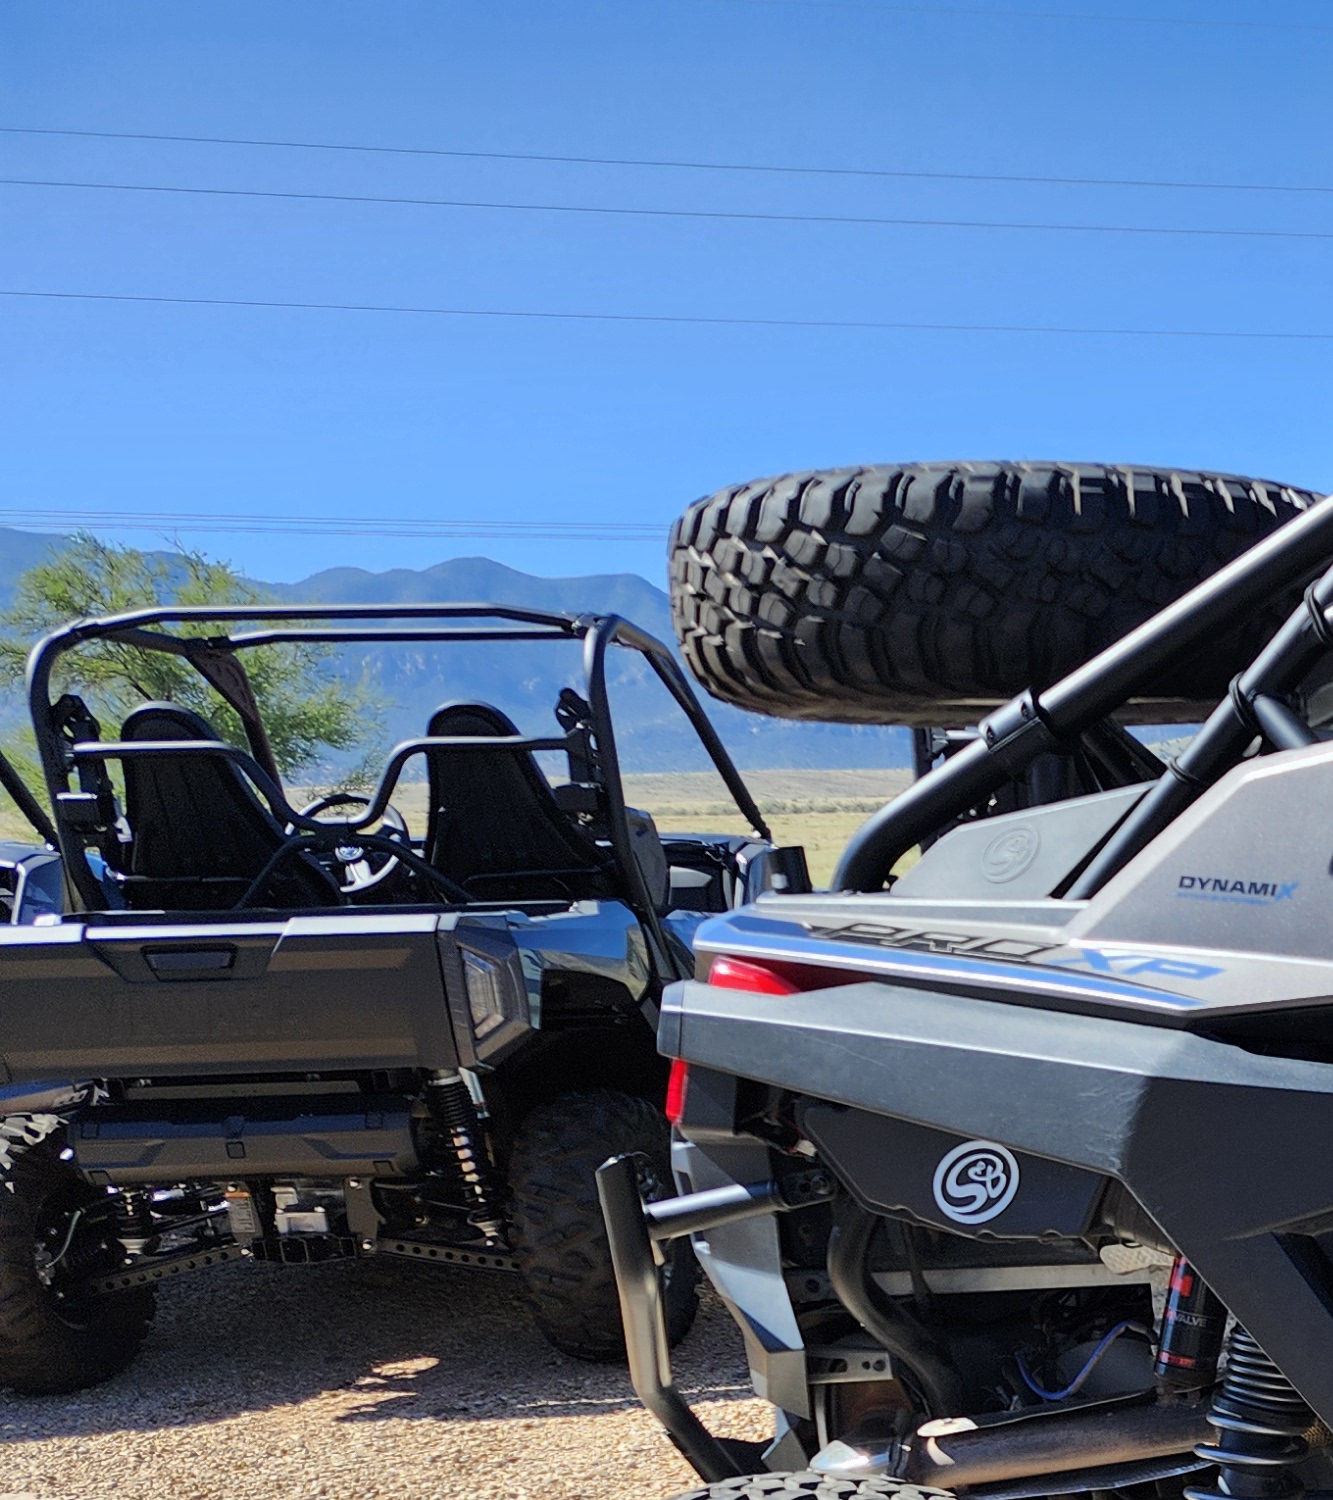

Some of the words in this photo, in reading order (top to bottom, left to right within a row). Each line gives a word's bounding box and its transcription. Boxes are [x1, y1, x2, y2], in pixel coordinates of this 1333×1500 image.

[1179, 876, 1299, 900] DYNAMIX
[808, 922, 1066, 962] PRO
[1044, 948, 1228, 980] XP
